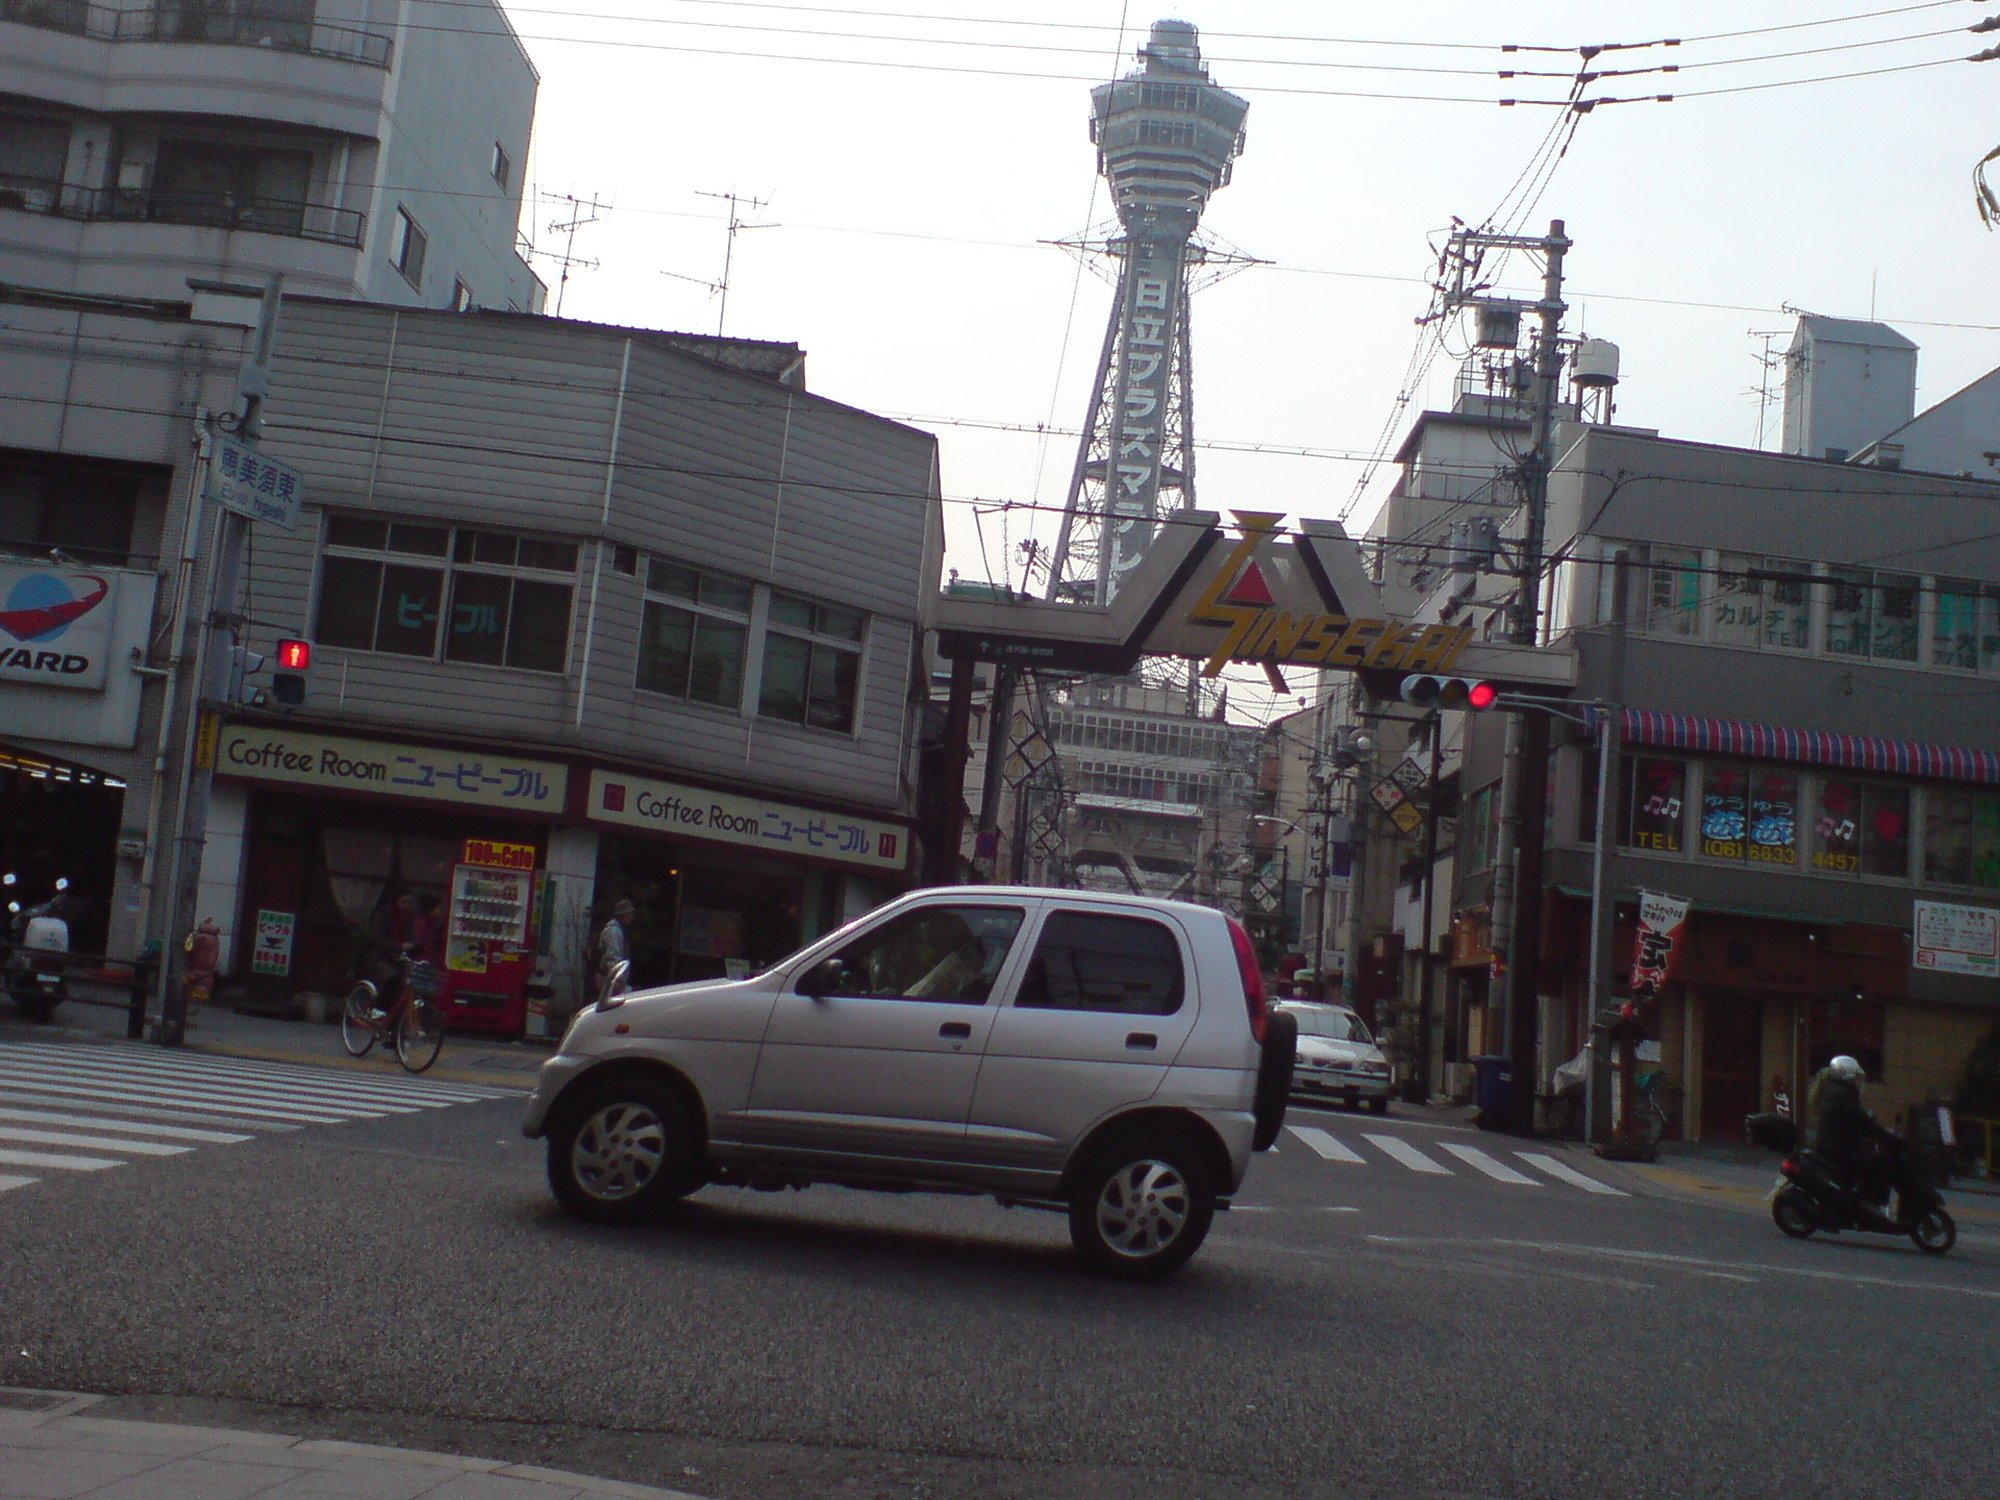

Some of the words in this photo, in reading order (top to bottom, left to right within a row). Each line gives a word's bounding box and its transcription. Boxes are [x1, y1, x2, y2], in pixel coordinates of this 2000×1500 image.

[219, 447, 297, 504] 恵美須東
[228, 738, 313, 771] Coffee
[320, 750, 387, 782] Room
[392, 756, 549, 800] ニューピープル
[636, 791, 703, 826] Coffee
[708, 804, 758, 836] Room
[762, 812, 869, 855] ニューピープル
[1637, 831, 1678, 851] TEL
